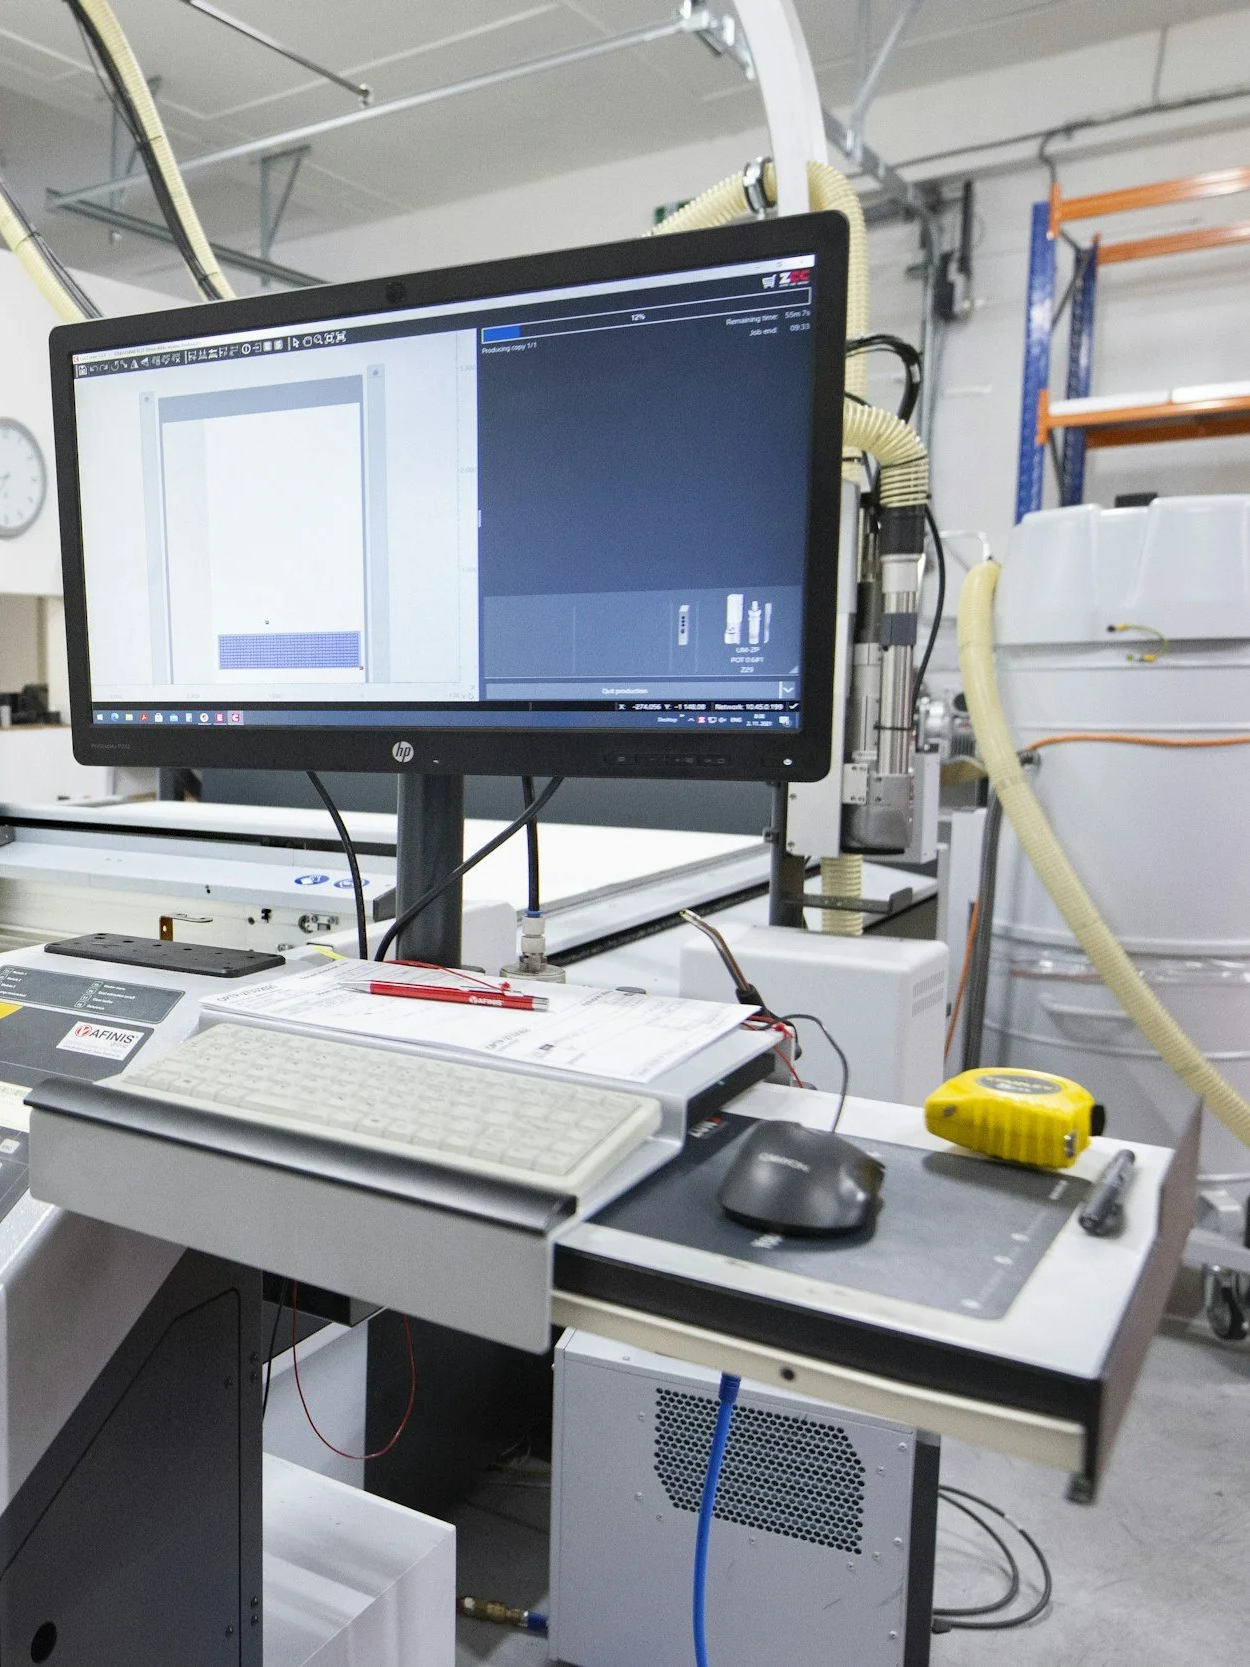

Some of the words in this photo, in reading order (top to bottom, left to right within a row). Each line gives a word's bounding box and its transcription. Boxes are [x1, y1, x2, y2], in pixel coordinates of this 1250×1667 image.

[631, 313, 646, 322] 12%
[726, 316, 761, 326] Remaining
[762, 314, 778, 322] time:
[784, 310, 801, 319] 55m
[802, 309, 810, 317] 7s
[749, 329, 762, 337] Job
[790, 323, 810, 332] 09:33
[481, 345, 510, 355] Producing
[510, 344, 526, 353] copy
[527, 341, 538, 350] 1/1
[393, 741, 413, 763] hp
[89, 1029, 135, 1044] AFINIS
